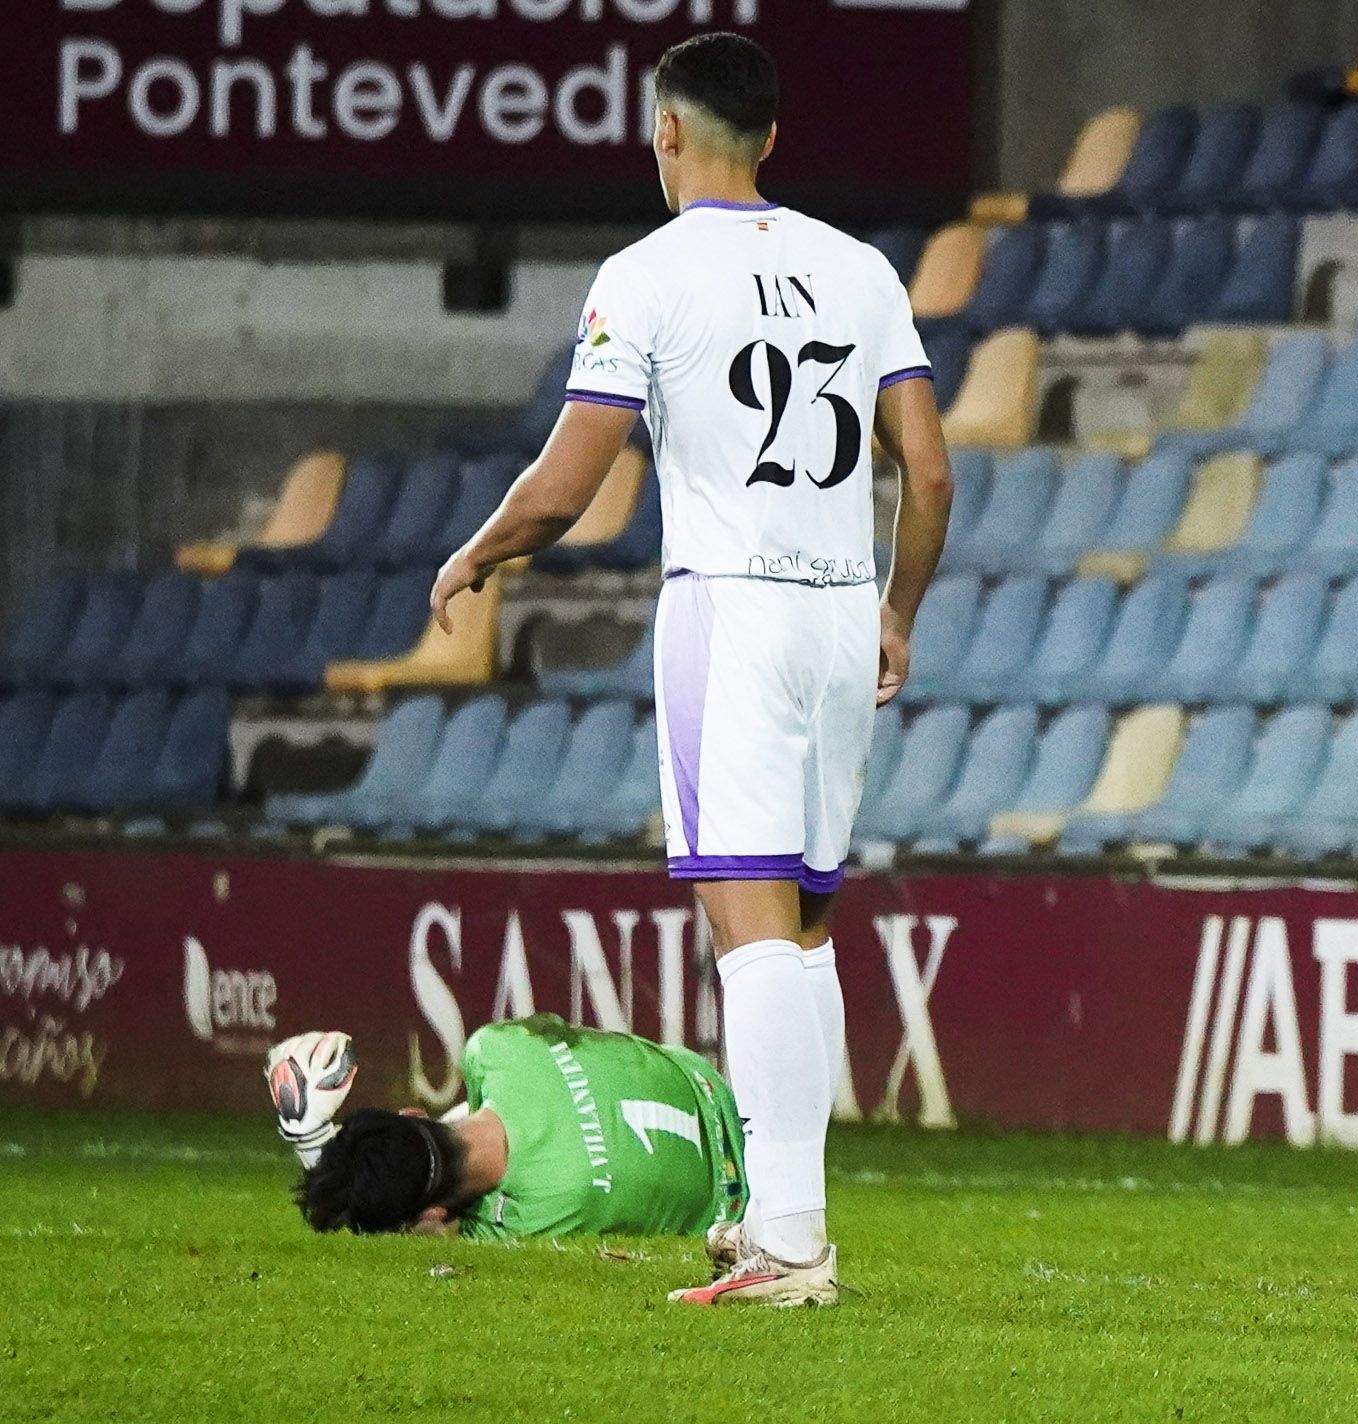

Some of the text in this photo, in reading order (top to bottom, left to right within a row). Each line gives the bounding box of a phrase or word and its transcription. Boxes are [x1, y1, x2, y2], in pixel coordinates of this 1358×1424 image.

[57, 38, 656, 146] Pontevedr
[752, 273, 817, 318] IAN
[728, 339, 861, 489] 23
[409, 899, 960, 1129] SANIX
[620, 1098, 703, 1161] 1
